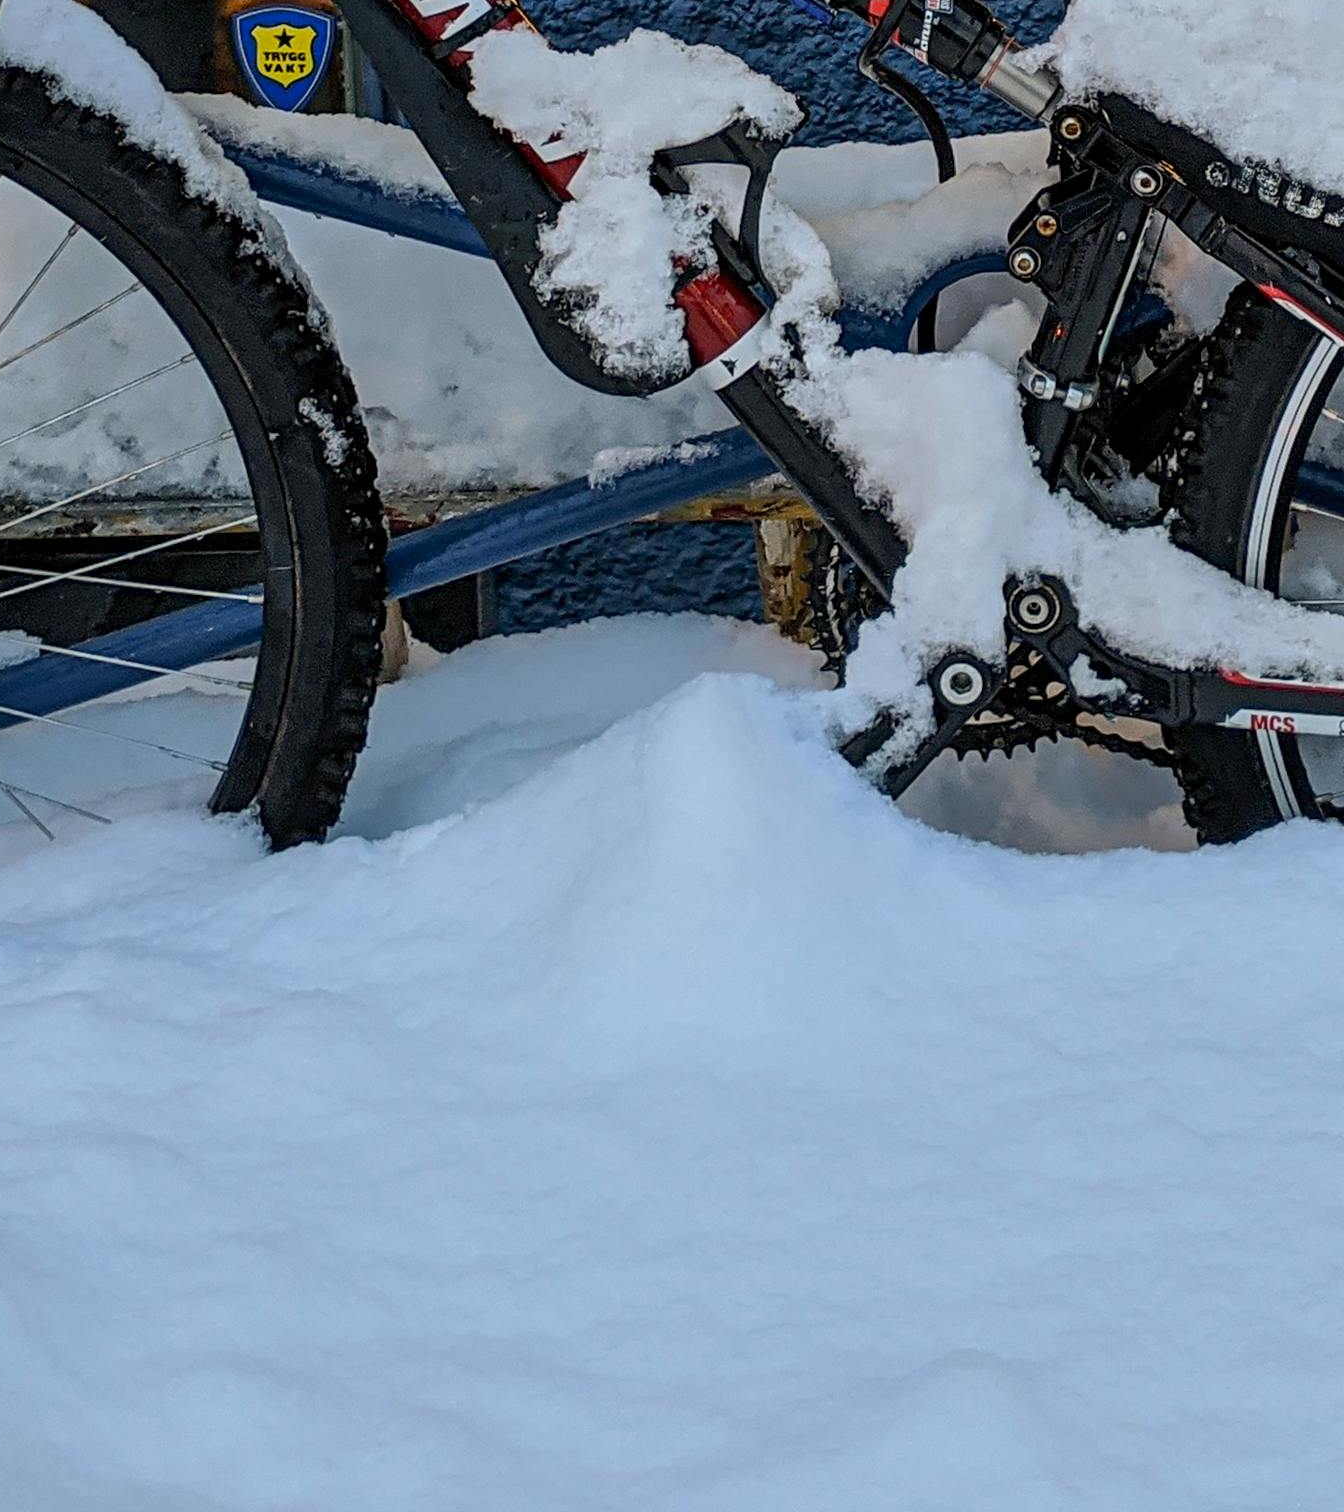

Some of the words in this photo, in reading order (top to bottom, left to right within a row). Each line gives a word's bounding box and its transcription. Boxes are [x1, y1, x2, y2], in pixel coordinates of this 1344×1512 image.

[263, 52, 306, 62] TRYGG
[264, 64, 306, 73] VAKT
[1251, 714, 1295, 734] MCS
